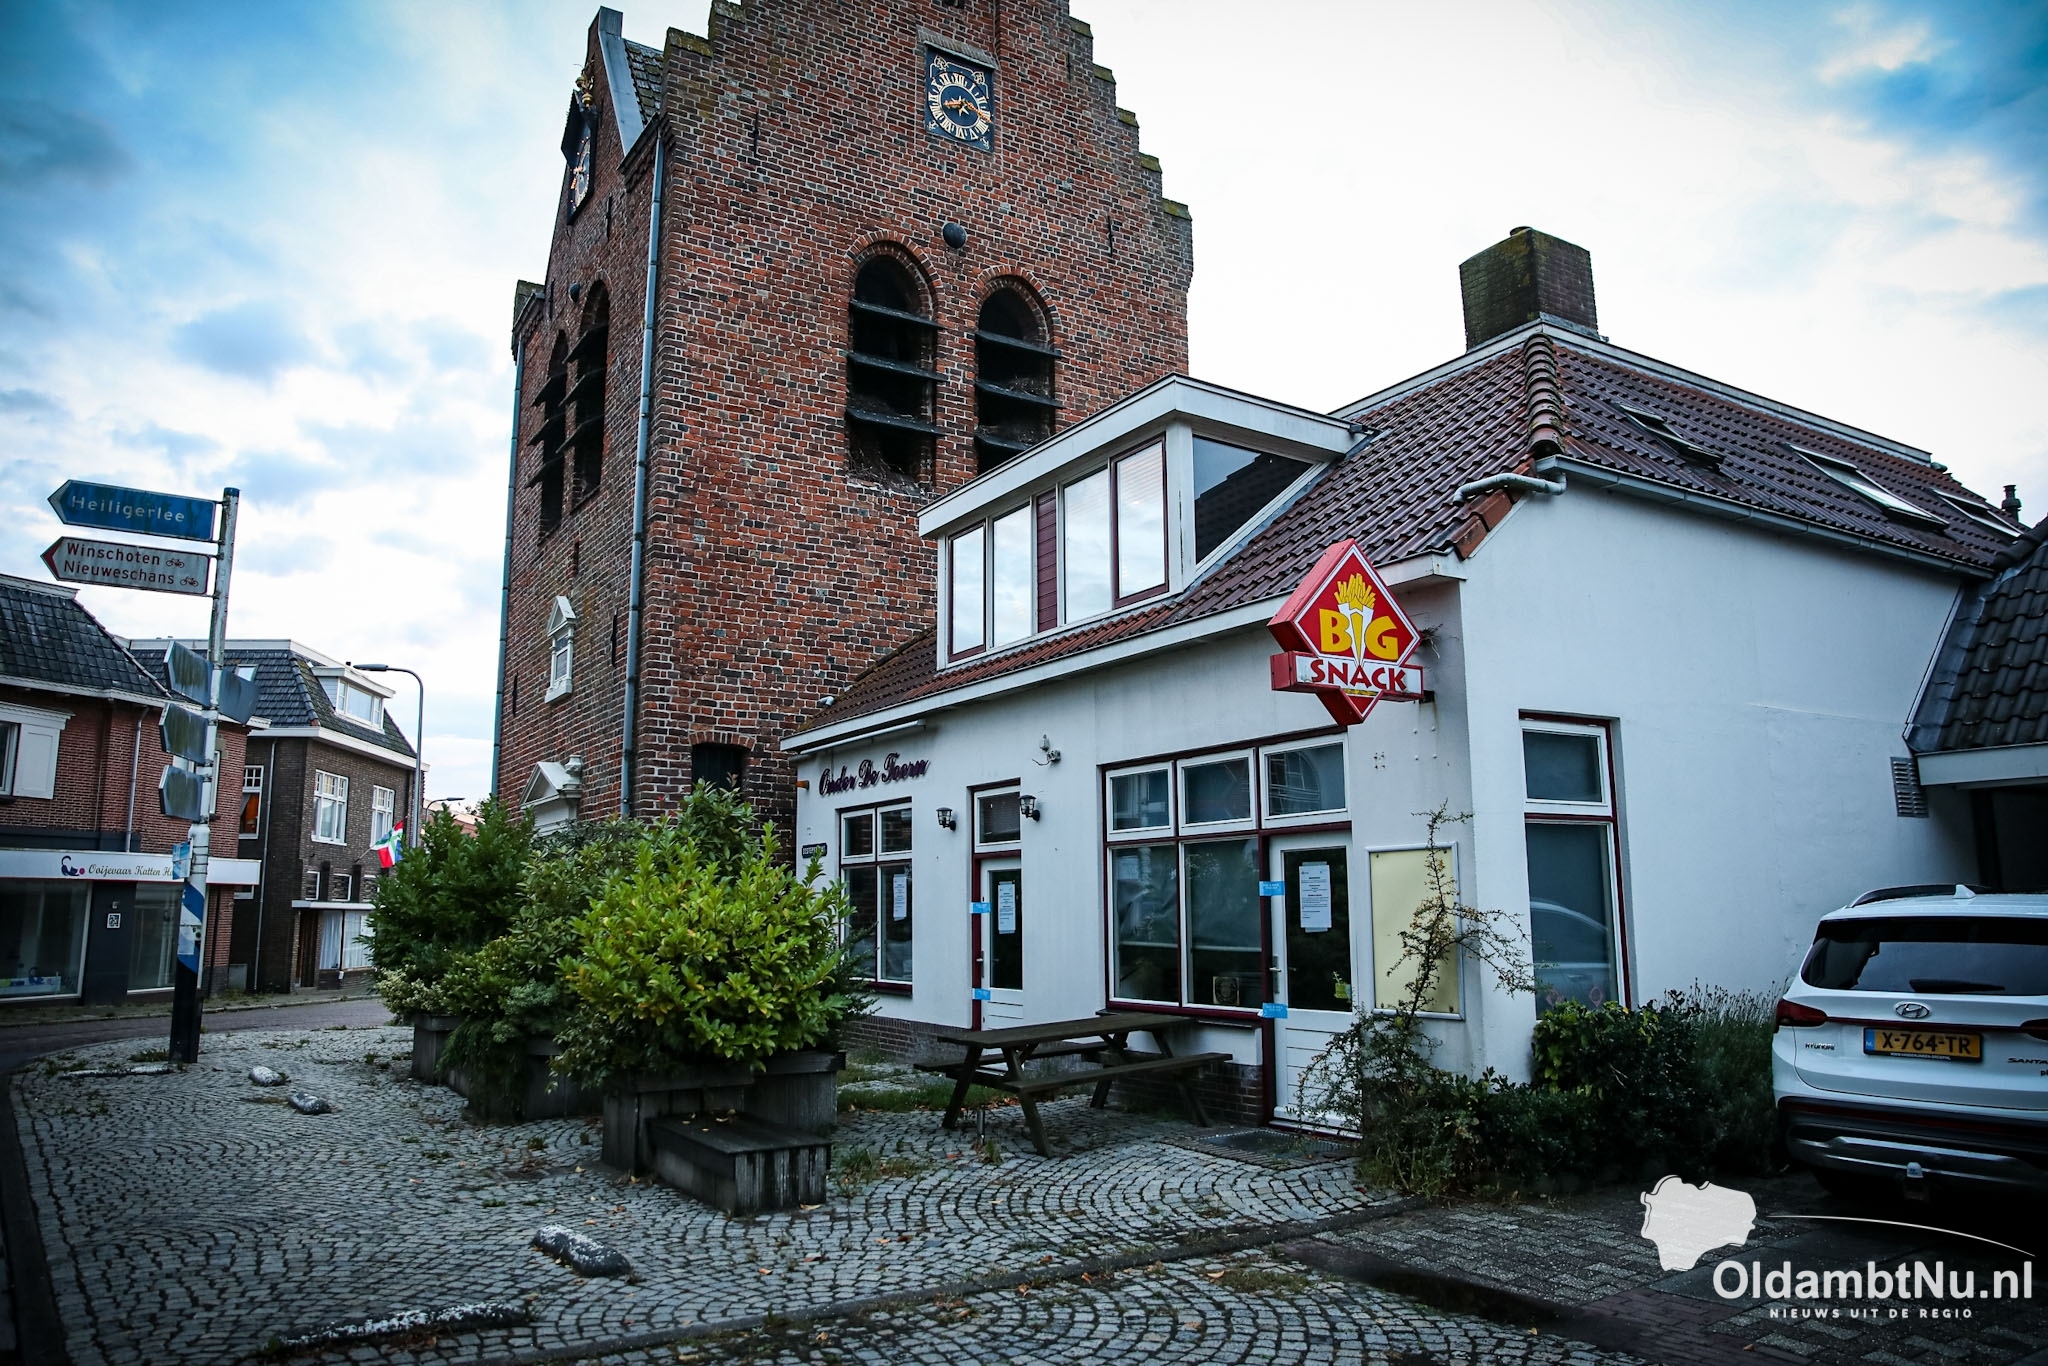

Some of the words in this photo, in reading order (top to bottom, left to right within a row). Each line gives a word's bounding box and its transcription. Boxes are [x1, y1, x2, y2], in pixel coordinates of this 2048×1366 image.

[931, 79, 943, 91] X
[953, 73, 965, 86] XII
[969, 83, 976, 92] I
[976, 95, 988, 104] II
[970, 128, 979, 140] V
[72, 496, 185, 522] Heiligerlee
[67, 543, 160, 565] Winschoten
[64, 561, 174, 584] Nieuweschans
[1319, 608, 1399, 661] BIG
[1311, 659, 1408, 691] SNACK
[858, 759, 880, 788] De
[88, 863, 132, 878] Ooijevaar
[134, 865, 161, 877] Katten
[1882, 1032, 1971, 1055] X-764-TR
